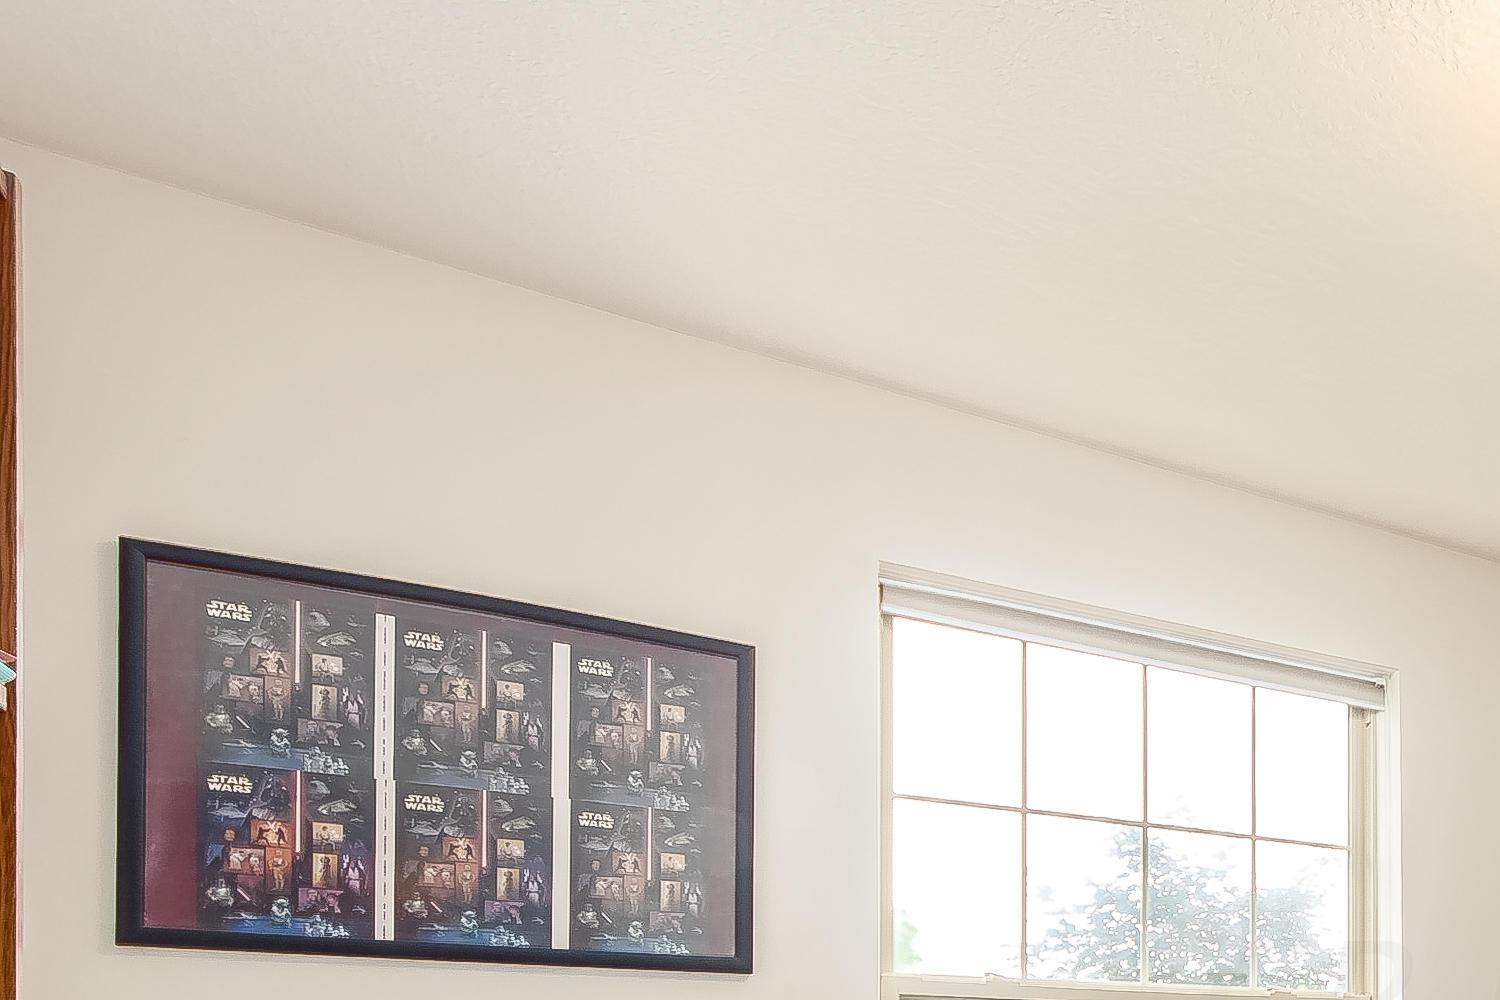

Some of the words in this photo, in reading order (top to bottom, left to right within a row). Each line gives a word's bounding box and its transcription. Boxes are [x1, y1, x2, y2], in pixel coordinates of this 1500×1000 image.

[207, 599, 252, 613] STAR
[207, 609, 252, 622] WARS
[403, 630, 443, 643] STAR
[404, 639, 445, 651] WARS
[577, 658, 612, 669] STAR
[578, 666, 613, 677] WARS
[207, 772, 252, 786] STAR
[208, 782, 253, 794] WARS
[404, 794, 444, 805] STAR
[404, 802, 445, 813] WARS
[577, 812, 614, 821] STAR
[578, 819, 614, 829] WARS
